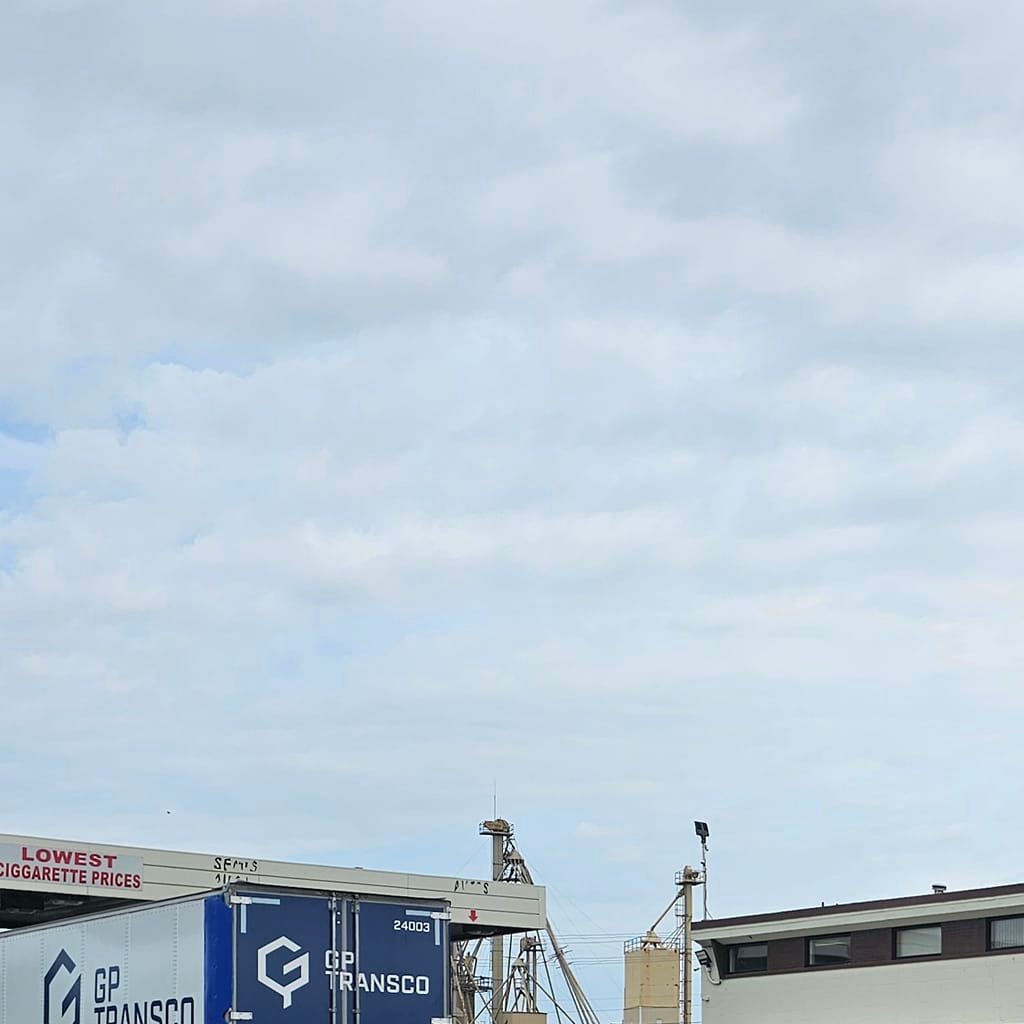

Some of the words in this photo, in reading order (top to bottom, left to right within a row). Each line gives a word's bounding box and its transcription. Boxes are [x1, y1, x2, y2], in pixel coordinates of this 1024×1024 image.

[22, 847, 117, 868] LOWEST
[92, 871, 141, 889] PRICES
[393, 920, 430, 933] 24003
[325, 950, 354, 970] GP
[94, 966, 120, 1003] GP
[325, 971, 430, 995] TRANSCO
